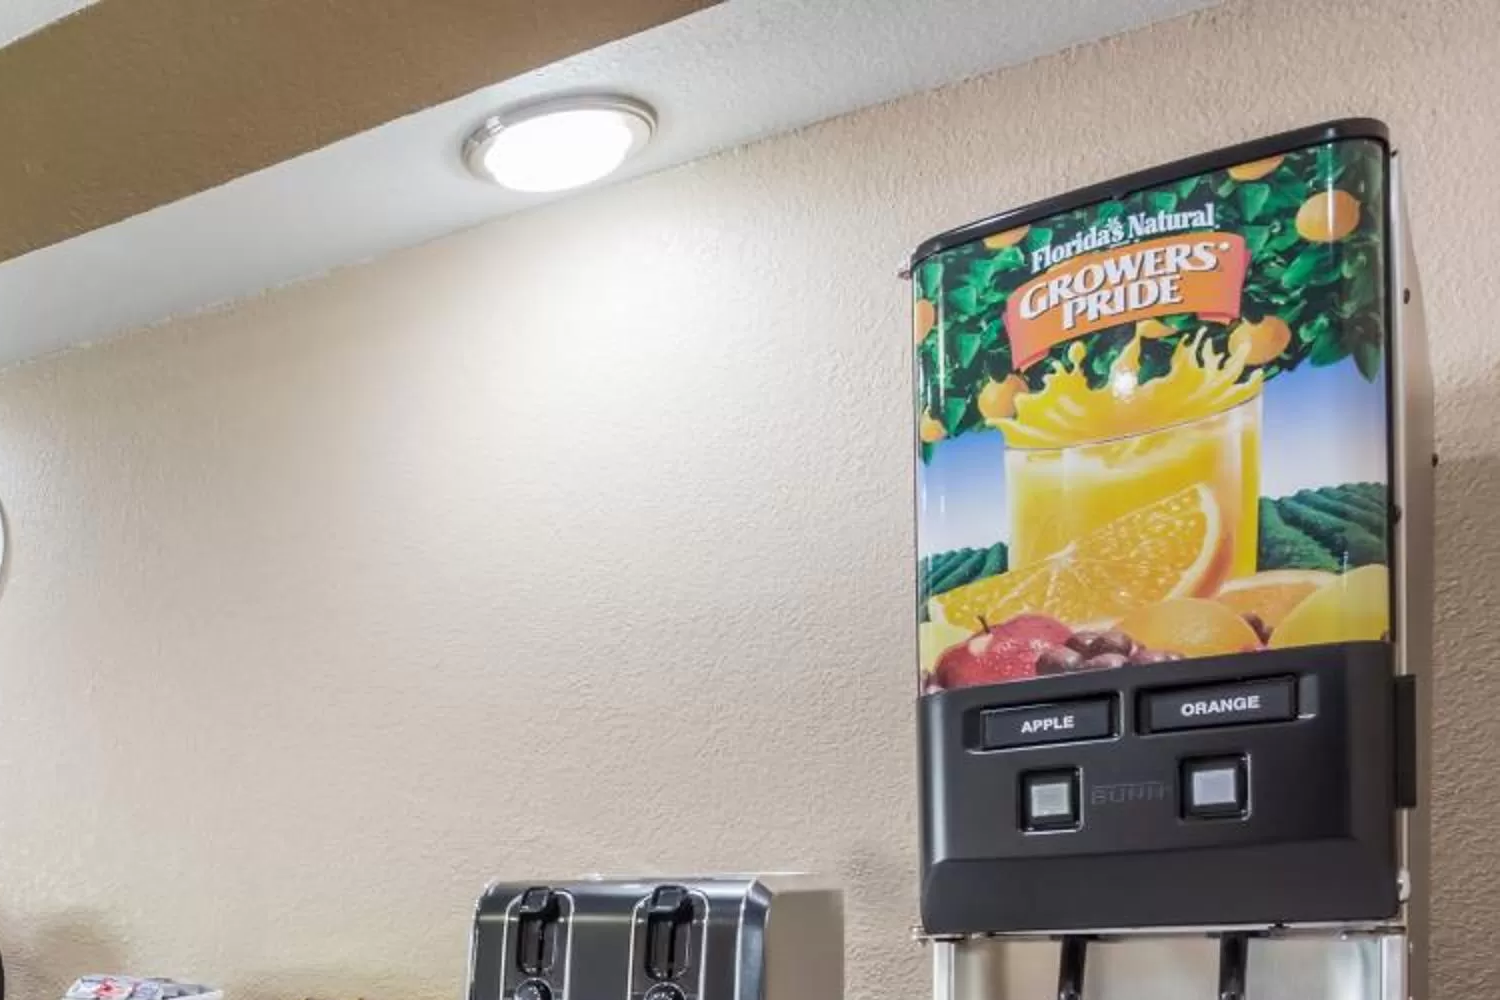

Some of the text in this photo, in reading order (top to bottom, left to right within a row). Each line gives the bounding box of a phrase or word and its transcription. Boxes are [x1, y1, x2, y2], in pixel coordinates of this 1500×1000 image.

[1030, 202, 1216, 274] Florida's Natural
[1062, 274, 1184, 330] PRIDE
[1021, 715, 1076, 734] APPLE
[1180, 695, 1261, 717] ORANGE
